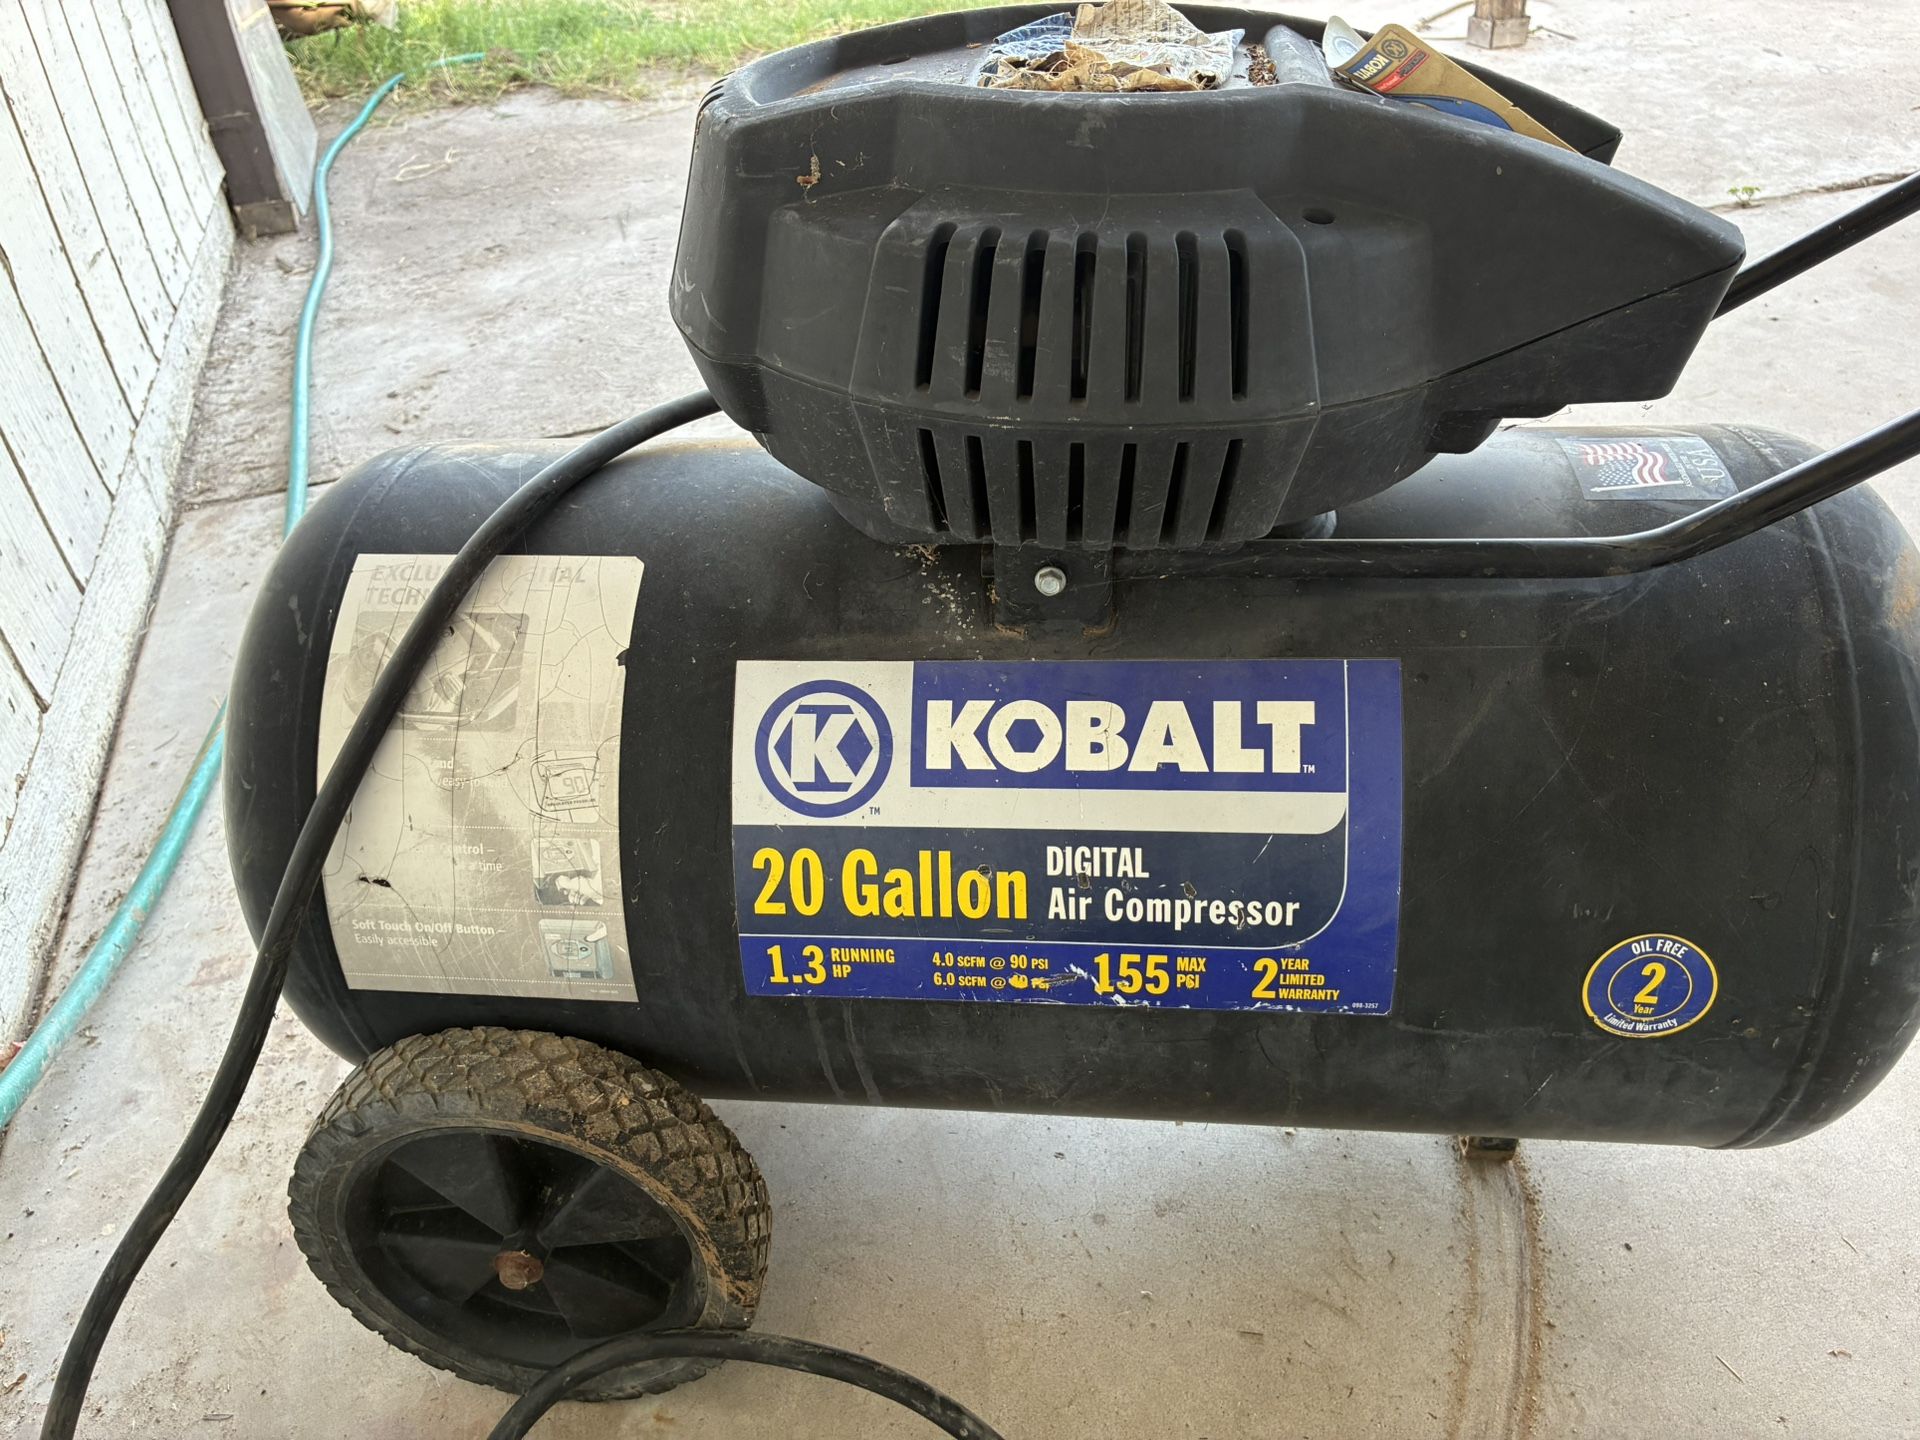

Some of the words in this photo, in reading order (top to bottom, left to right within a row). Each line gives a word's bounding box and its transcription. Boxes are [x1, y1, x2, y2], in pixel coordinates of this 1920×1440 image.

[1686, 448, 1725, 480] USA
[925, 699, 1316, 774] KOBALT
[479, 860, 503, 872] time
[1046, 845, 1150, 878] DIGITAL
[752, 847, 824, 916] 20
[841, 848, 1028, 920] Gallon
[1048, 887, 1092, 920] Air
[1104, 887, 1300, 931] Compressor
[352, 918, 376, 931] Soft
[377, 920, 412, 933] Touch
[414, 921, 453, 934] On/Off
[455, 923, 495, 936] Button
[355, 933, 384, 947] Easily
[387, 935, 438, 948] accessible
[1631, 939, 1654, 956] OIL
[1655, 938, 1689, 959] FREE
[766, 944, 827, 985] 1.3
[830, 947, 895, 964] RUNNING
[932, 951, 954, 968] 4.0
[957, 956, 986, 968] SCFM
[989, 957, 1006, 970] @
[1010, 953, 1028, 969] 90
[1031, 958, 1049, 970] PSI
[1176, 957, 1207, 972] MAX
[1280, 957, 1310, 971] YEAR
[832, 963, 852, 979] HP
[933, 971, 956, 987] 6.0
[958, 975, 987, 988] SCFM
[990, 976, 1007, 989] @
[1094, 953, 1170, 994] 155
[1251, 957, 1279, 999] 2
[1279, 973, 1325, 986] LIMITED
[1176, 974, 1200, 989] PSI
[1633, 961, 1667, 1005] 2
[1278, 987, 1341, 1001] WARRANTY
[1633, 1003, 1655, 1015] Year
[1603, 1012, 1634, 1031] Limited
[1635, 1017, 1679, 1032] Warranty
